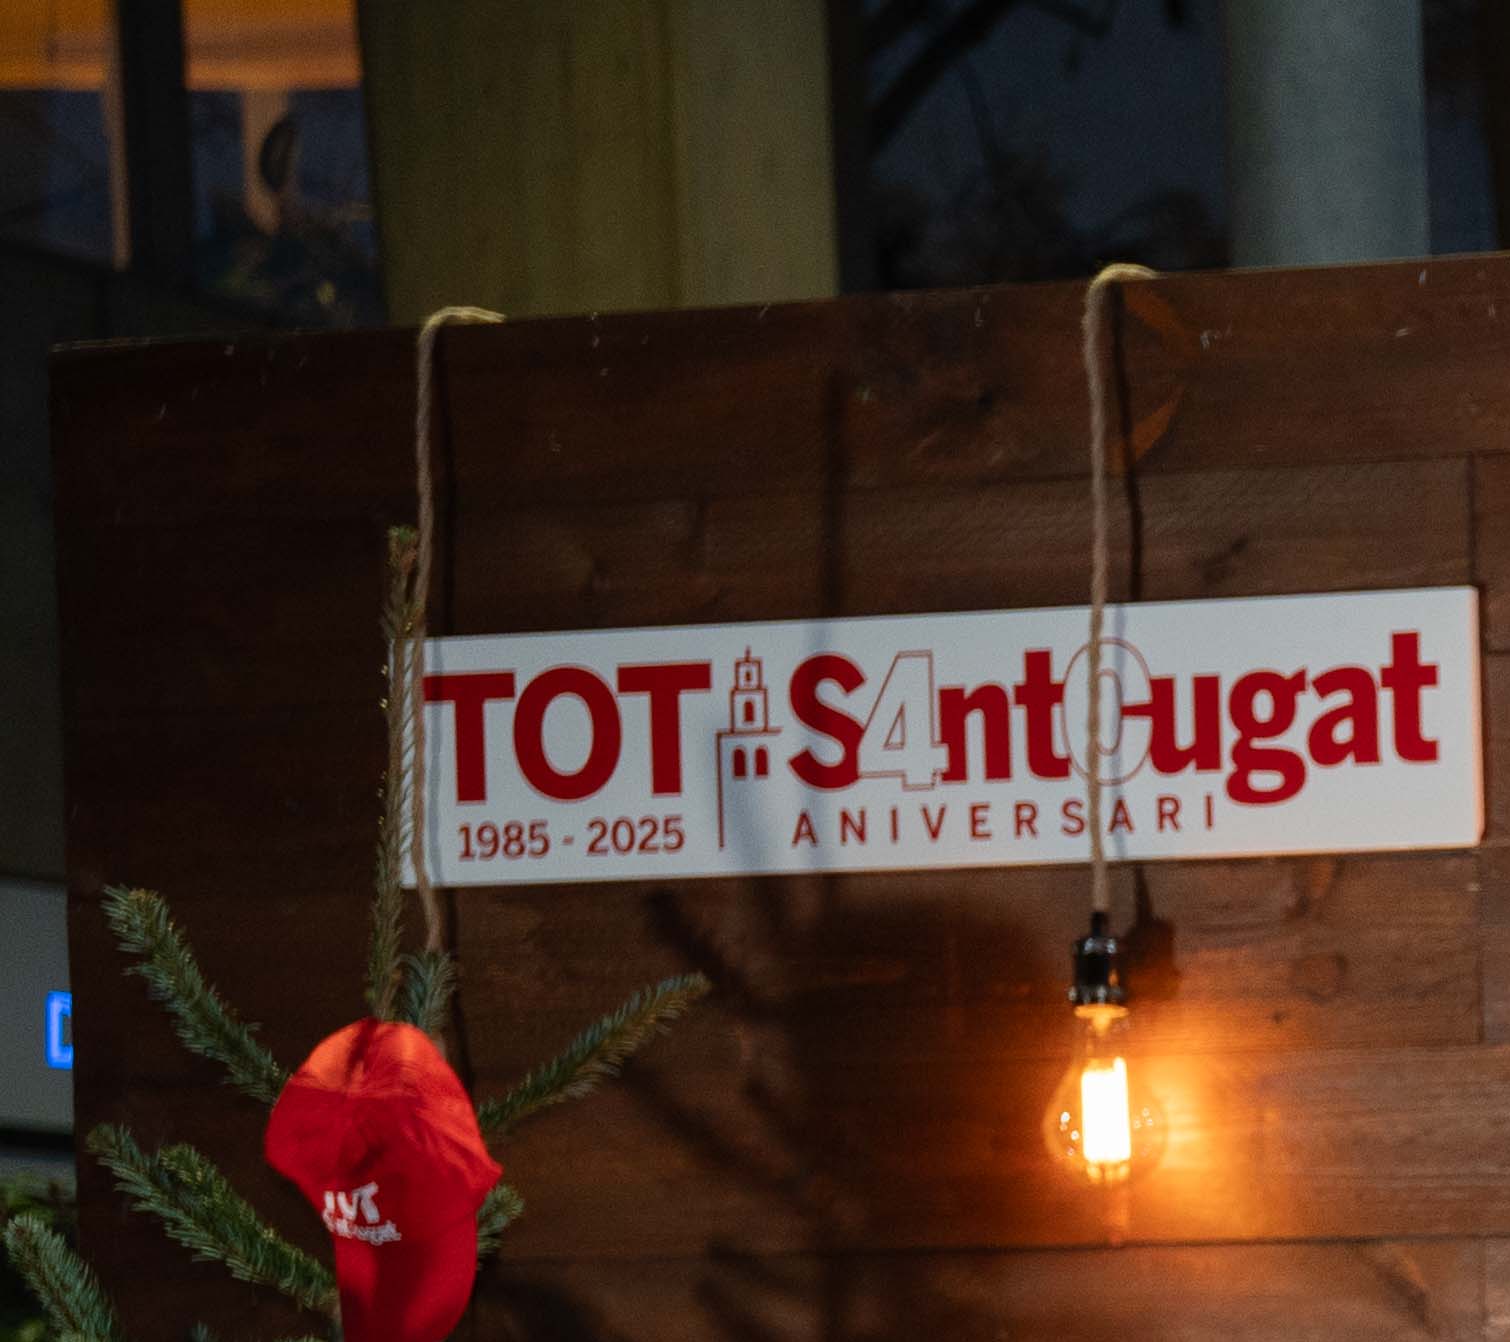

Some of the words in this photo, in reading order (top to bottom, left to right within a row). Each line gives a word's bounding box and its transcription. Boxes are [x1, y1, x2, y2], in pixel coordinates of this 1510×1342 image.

[422, 660, 713, 804] TOT
[458, 819, 550, 861] 1985
[585, 814, 686, 857] 2025
[792, 794, 1214, 848] ANIVERSARI
